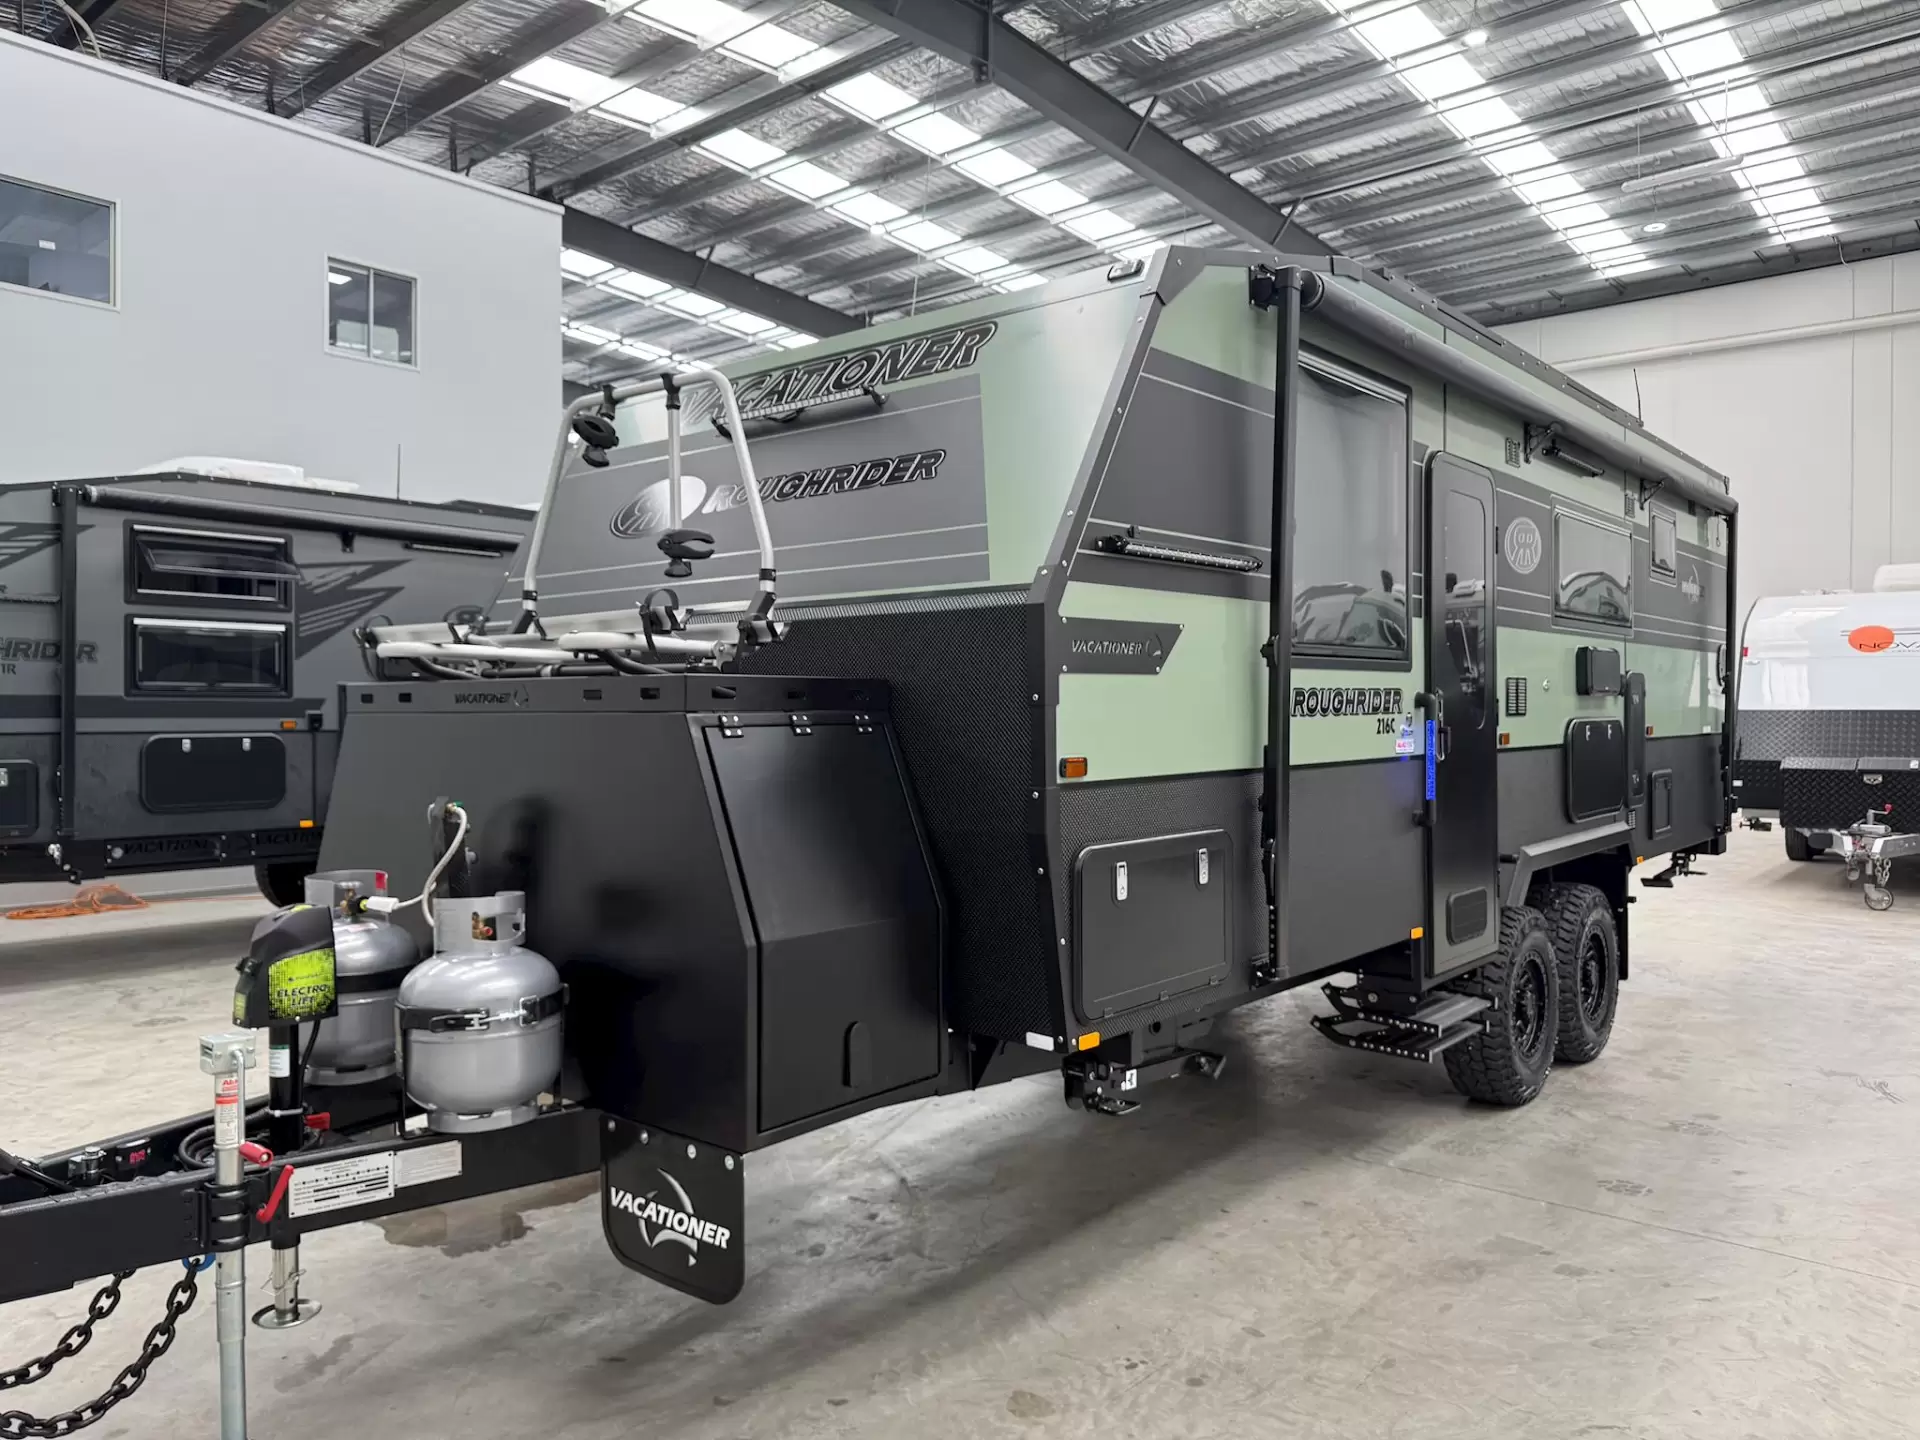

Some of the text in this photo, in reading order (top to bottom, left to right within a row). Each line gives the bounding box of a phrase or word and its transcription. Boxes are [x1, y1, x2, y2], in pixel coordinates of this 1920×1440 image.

[1071, 639, 1143, 655] VACATIONER
[1290, 687, 1404, 718] ROUGHRIDER
[1376, 717, 1396, 735] 216C
[276, 983, 328, 998] ELECTRO
[610, 1186, 731, 1250] VACATIONER
